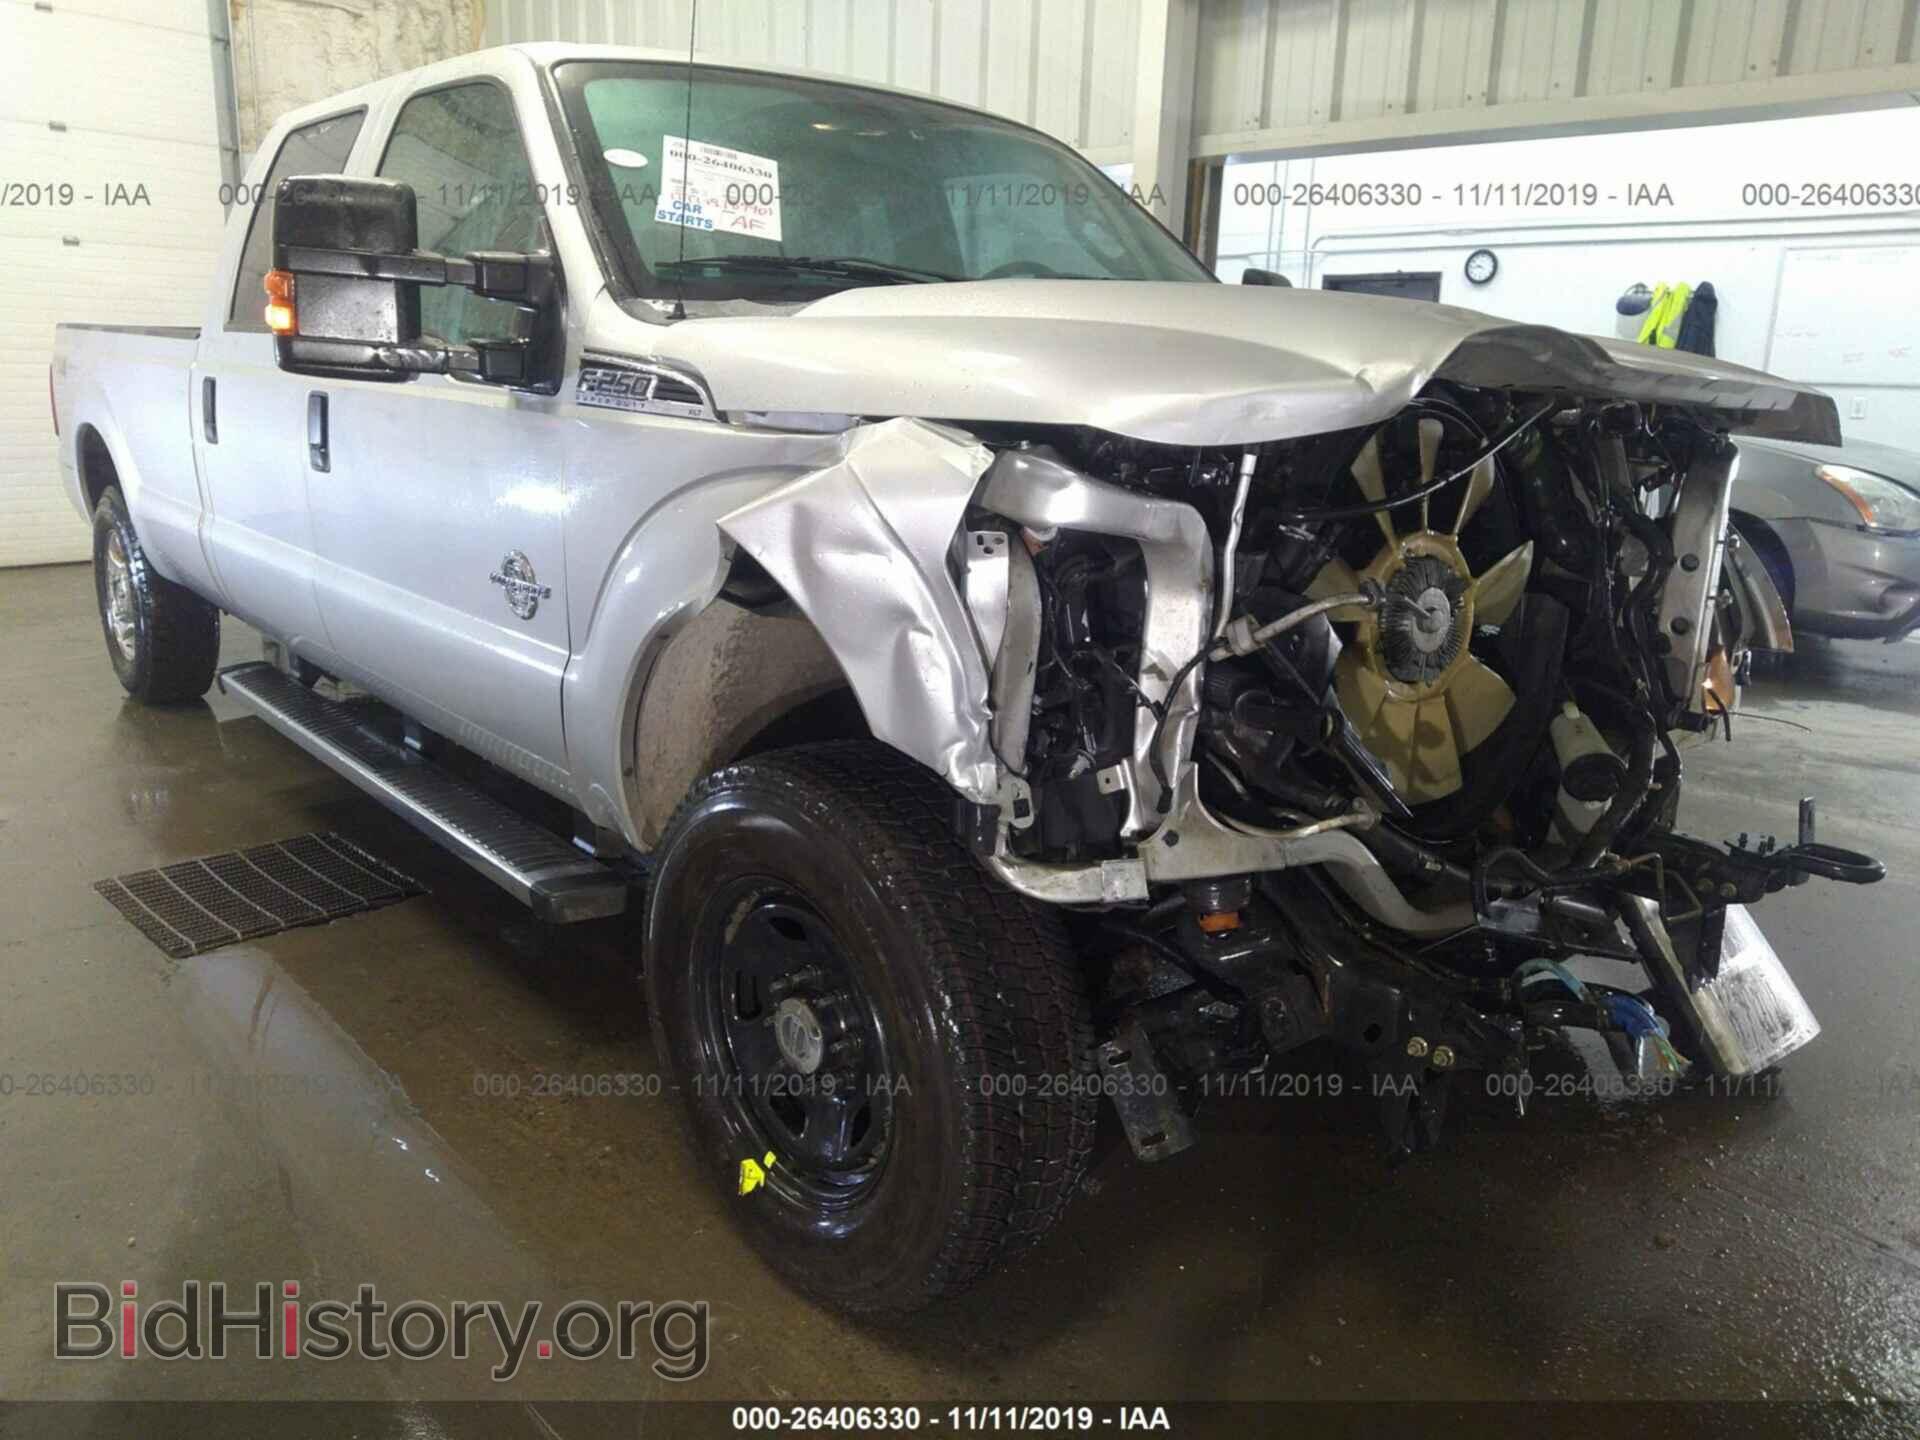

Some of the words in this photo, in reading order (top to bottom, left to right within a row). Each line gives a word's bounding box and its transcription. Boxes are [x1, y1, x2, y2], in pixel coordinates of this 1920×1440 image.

[672, 200, 702, 214] CAR
[657, 209, 713, 229] STARTS
[577, 368, 655, 400] F-250
